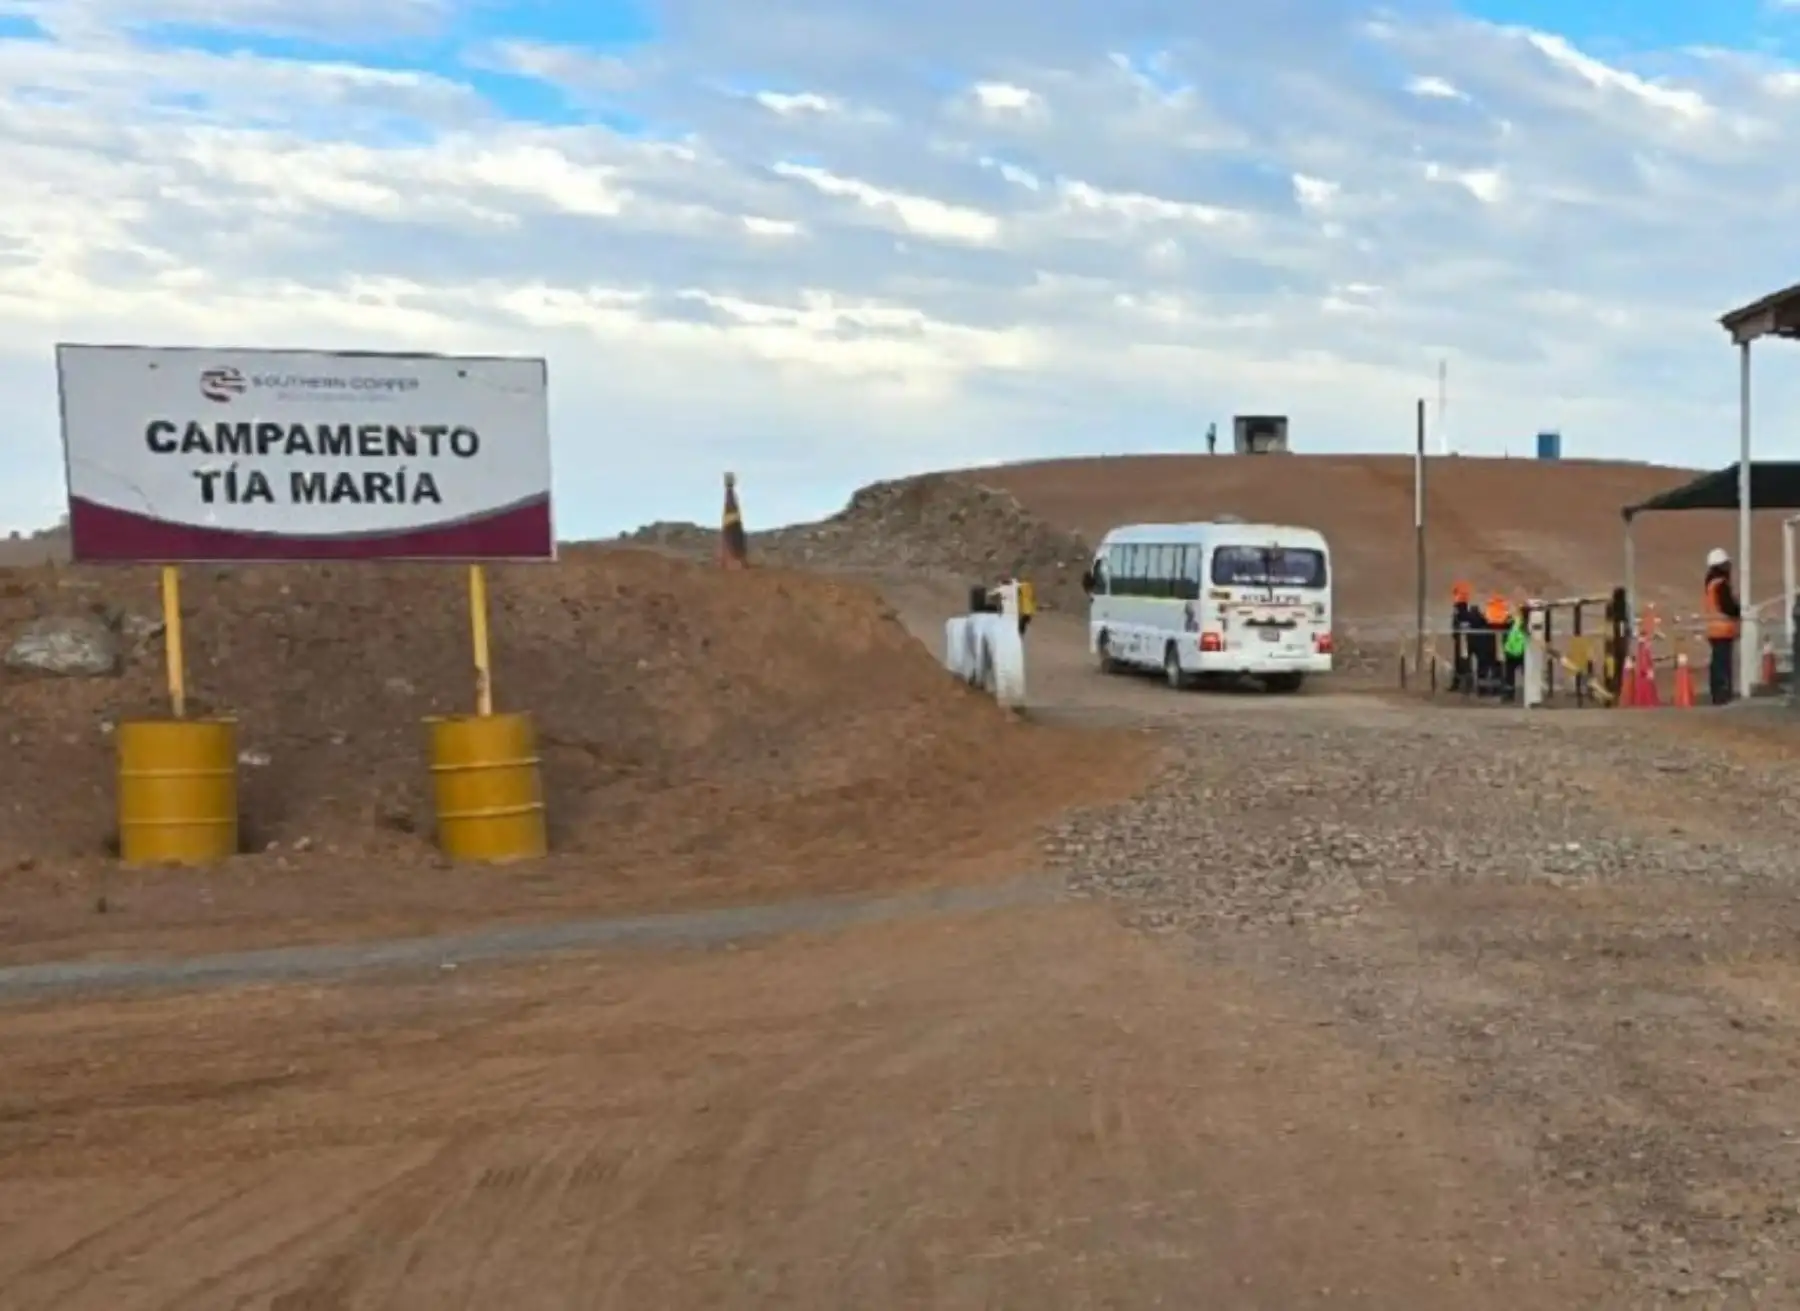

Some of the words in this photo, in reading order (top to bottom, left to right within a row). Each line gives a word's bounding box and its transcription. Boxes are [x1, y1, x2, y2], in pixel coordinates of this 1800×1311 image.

[252, 374, 347, 390] SOUTHERN
[145, 420, 480, 458] CAMPAMENTO
[193, 462, 275, 504] TÍA
[290, 466, 442, 504] MARÍA
